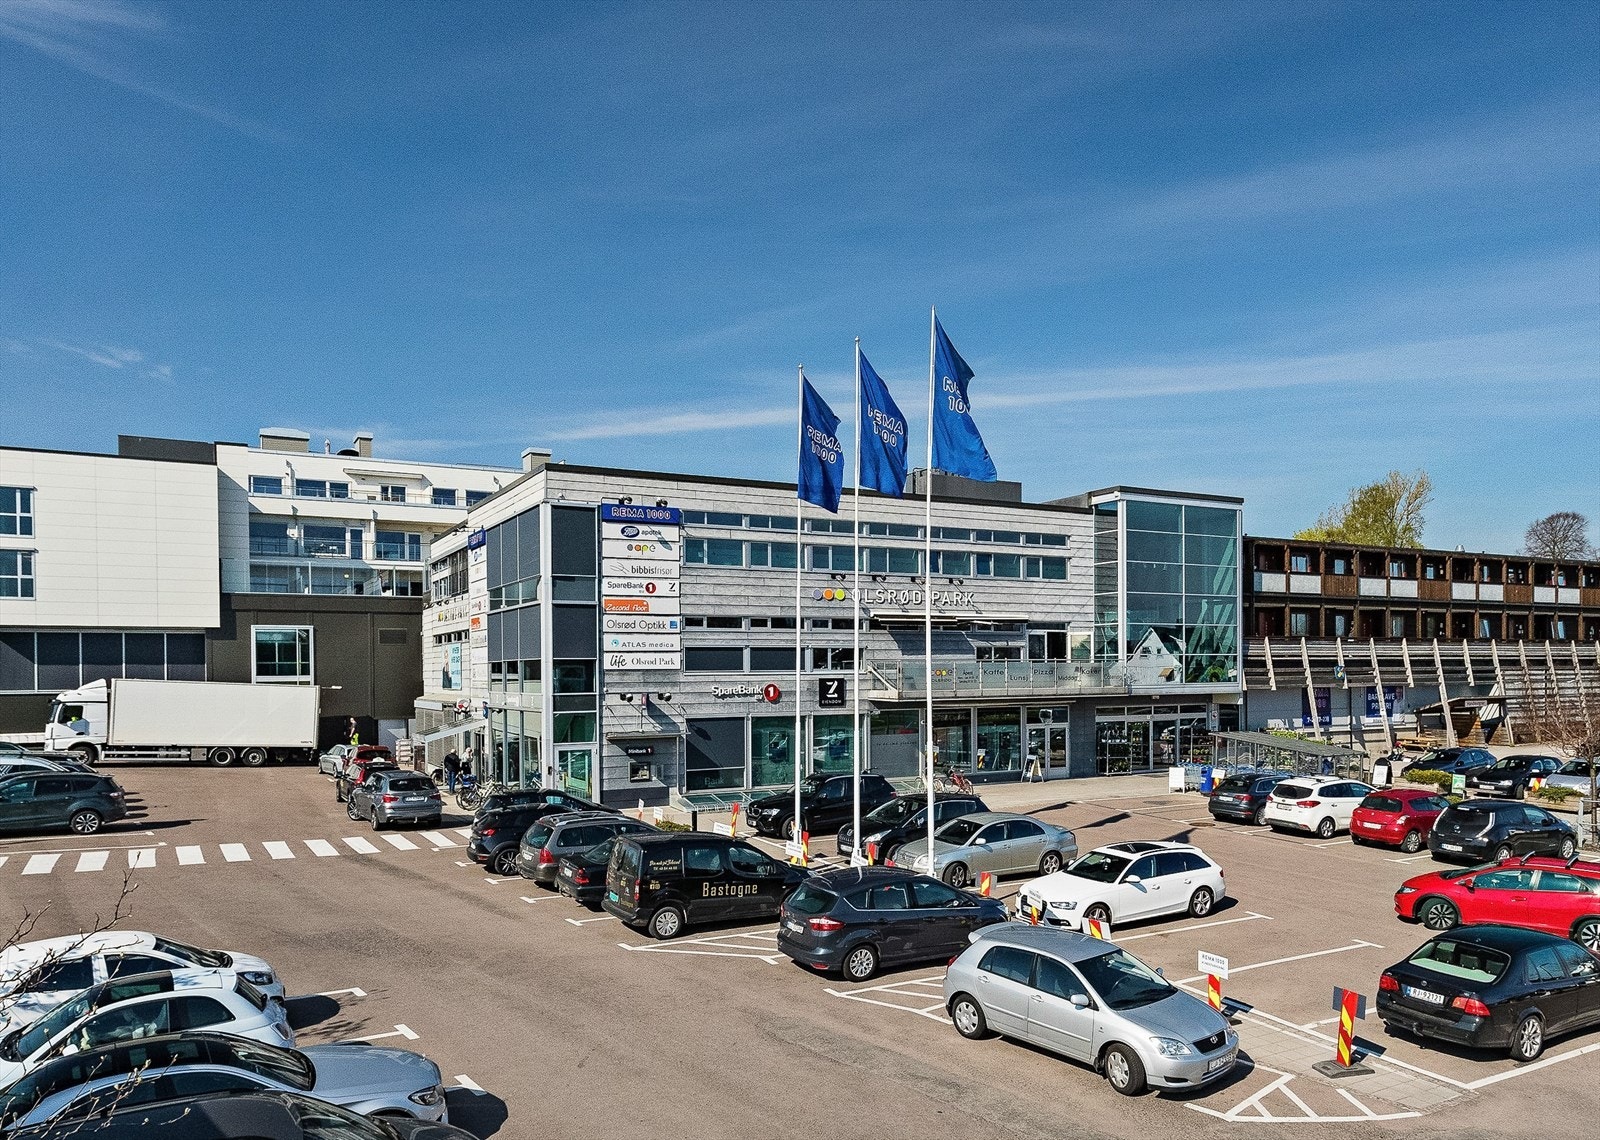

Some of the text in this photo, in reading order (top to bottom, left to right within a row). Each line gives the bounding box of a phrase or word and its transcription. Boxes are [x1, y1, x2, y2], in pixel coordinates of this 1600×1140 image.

[611, 507, 671, 519] REMA 1000
[607, 581, 645, 589] SpareBank
[931, 591, 975, 607] PARK
[606, 619, 667, 631] Olsrød Optikk
[609, 654, 628, 668] life
[659, 658, 676, 666] Park
[711, 685, 763, 696] SpareBank
[702, 881, 758, 898] Bastogne
